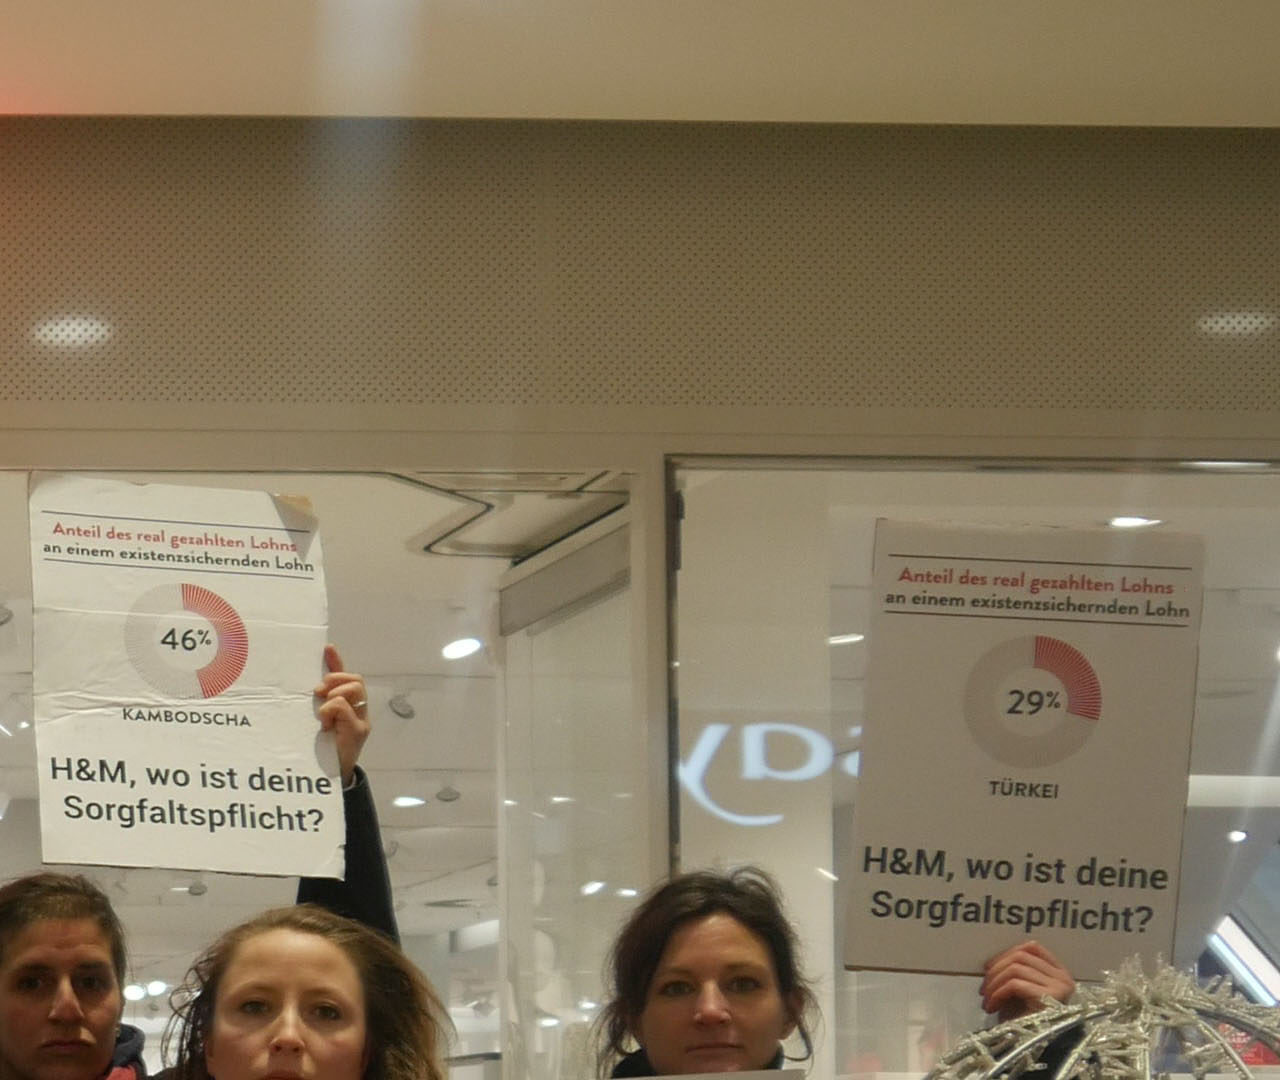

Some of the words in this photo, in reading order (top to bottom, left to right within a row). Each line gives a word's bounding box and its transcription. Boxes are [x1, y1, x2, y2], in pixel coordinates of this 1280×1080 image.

[52, 522, 101, 538] Anteil
[106, 525, 132, 541] des
[137, 529, 165, 543] real
[170, 532, 245, 550] gezahlten
[250, 536, 298, 552] Lohns
[43, 544, 62, 554] an
[66, 543, 115, 559] einem
[120, 548, 270, 569] existenzsichernden
[275, 556, 314, 572] Lohn
[898, 567, 953, 585] Anteil
[958, 570, 987, 587] des
[993, 572, 1024, 588] real
[1030, 574, 1114, 594] gezahlten
[1121, 576, 1174, 595] Lohns
[885, 593, 906, 605] an
[912, 591, 966, 608] einem
[970, 595, 1139, 616] existenzsichernden
[1145, 602, 1190, 618] Lohn
[160, 627, 211, 651] 46%
[1006, 689, 1060, 715] 29%
[122, 707, 252, 728] KAMBODSCHA
[50, 756, 137, 788] H&M,
[146, 768, 190, 787] wo
[200, 763, 239, 790] ist
[248, 767, 332, 795] deine
[989, 779, 1059, 799] TÜRKEI
[64, 795, 324, 832] Sorgfaltspflicht?
[863, 846, 954, 882] H&M,
[966, 857, 1014, 881] wo
[1025, 854, 1066, 884] ist
[1076, 856, 1168, 889] deine
[870, 890, 1153, 932] Sorgfaltspflicht?
